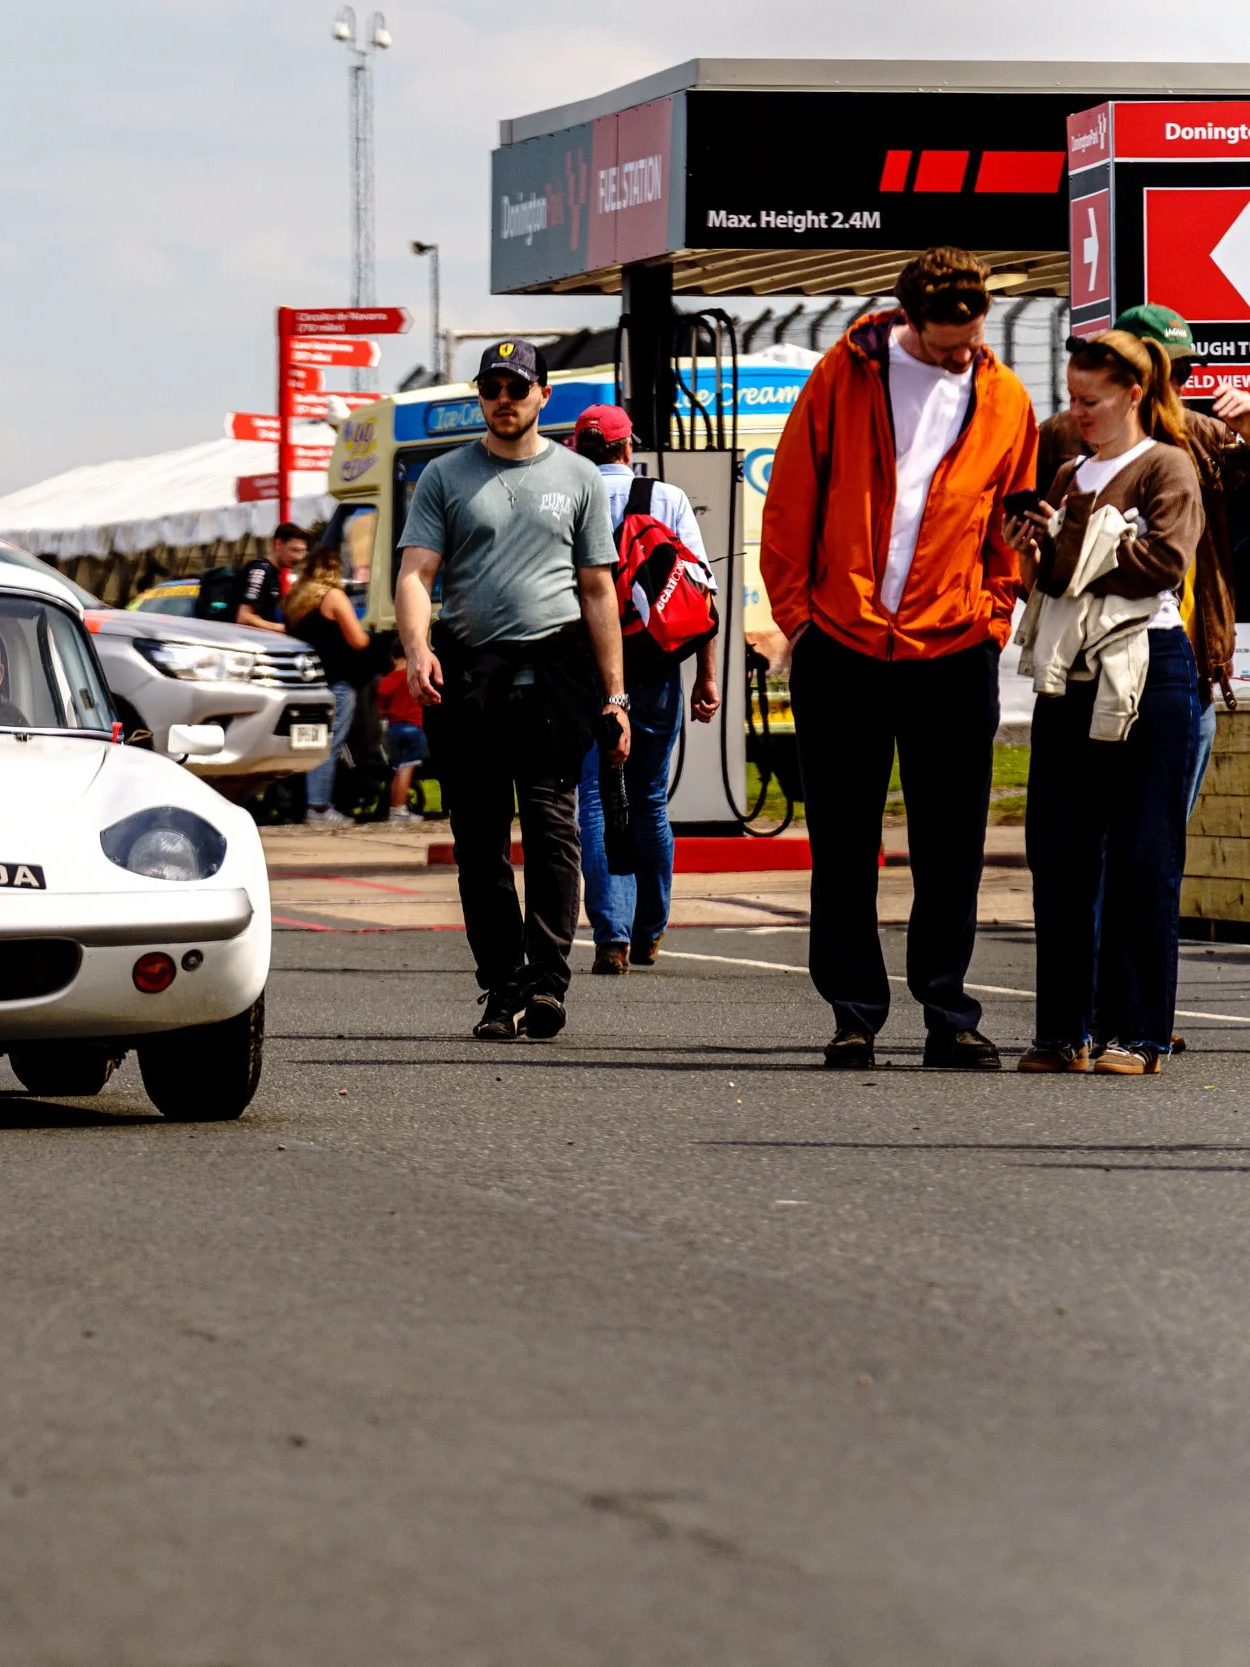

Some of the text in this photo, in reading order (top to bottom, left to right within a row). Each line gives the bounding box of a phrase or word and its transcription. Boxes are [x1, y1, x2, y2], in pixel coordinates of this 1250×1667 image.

[1165, 122, 1250, 145] Doningt
[598, 154, 663, 214] FUEL STATION
[707, 210, 881, 233] Max. Height 2.4M
